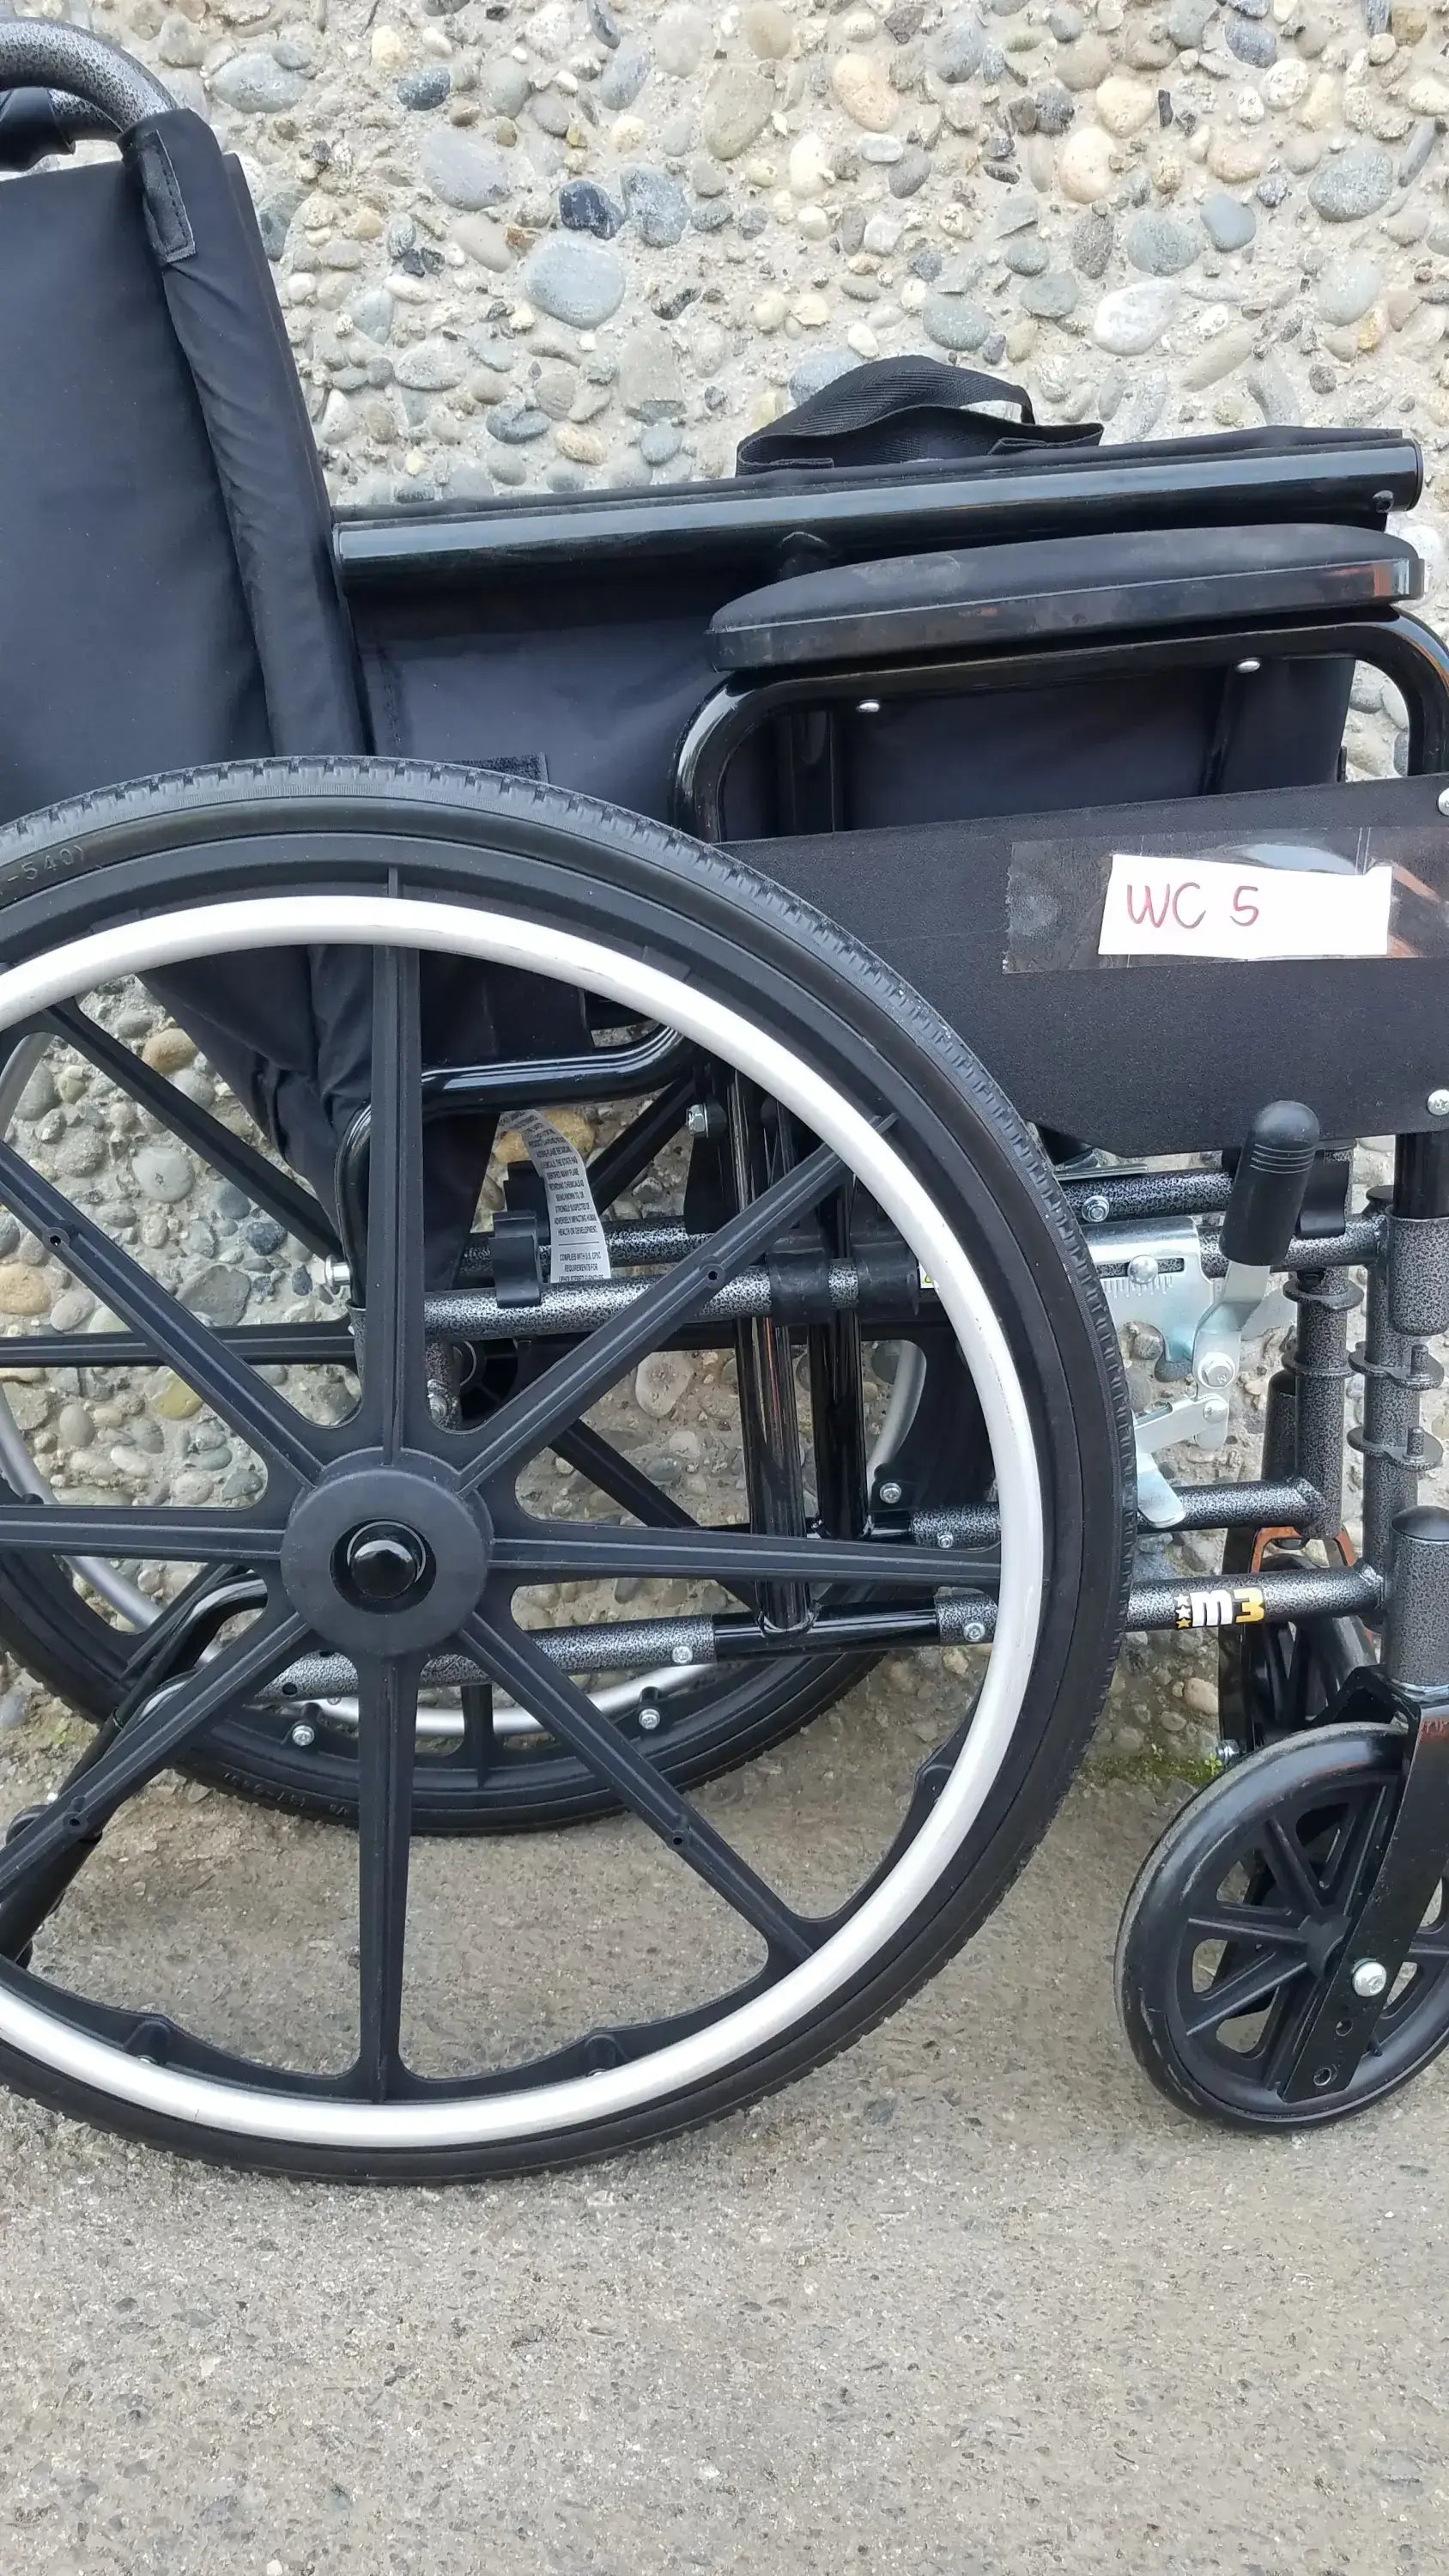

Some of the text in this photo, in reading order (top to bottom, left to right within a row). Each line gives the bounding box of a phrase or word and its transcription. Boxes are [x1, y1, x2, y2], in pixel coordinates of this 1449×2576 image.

[1126, 881, 1260, 930] WC 5
[560, 1253, 576, 1261] COMPLIES
